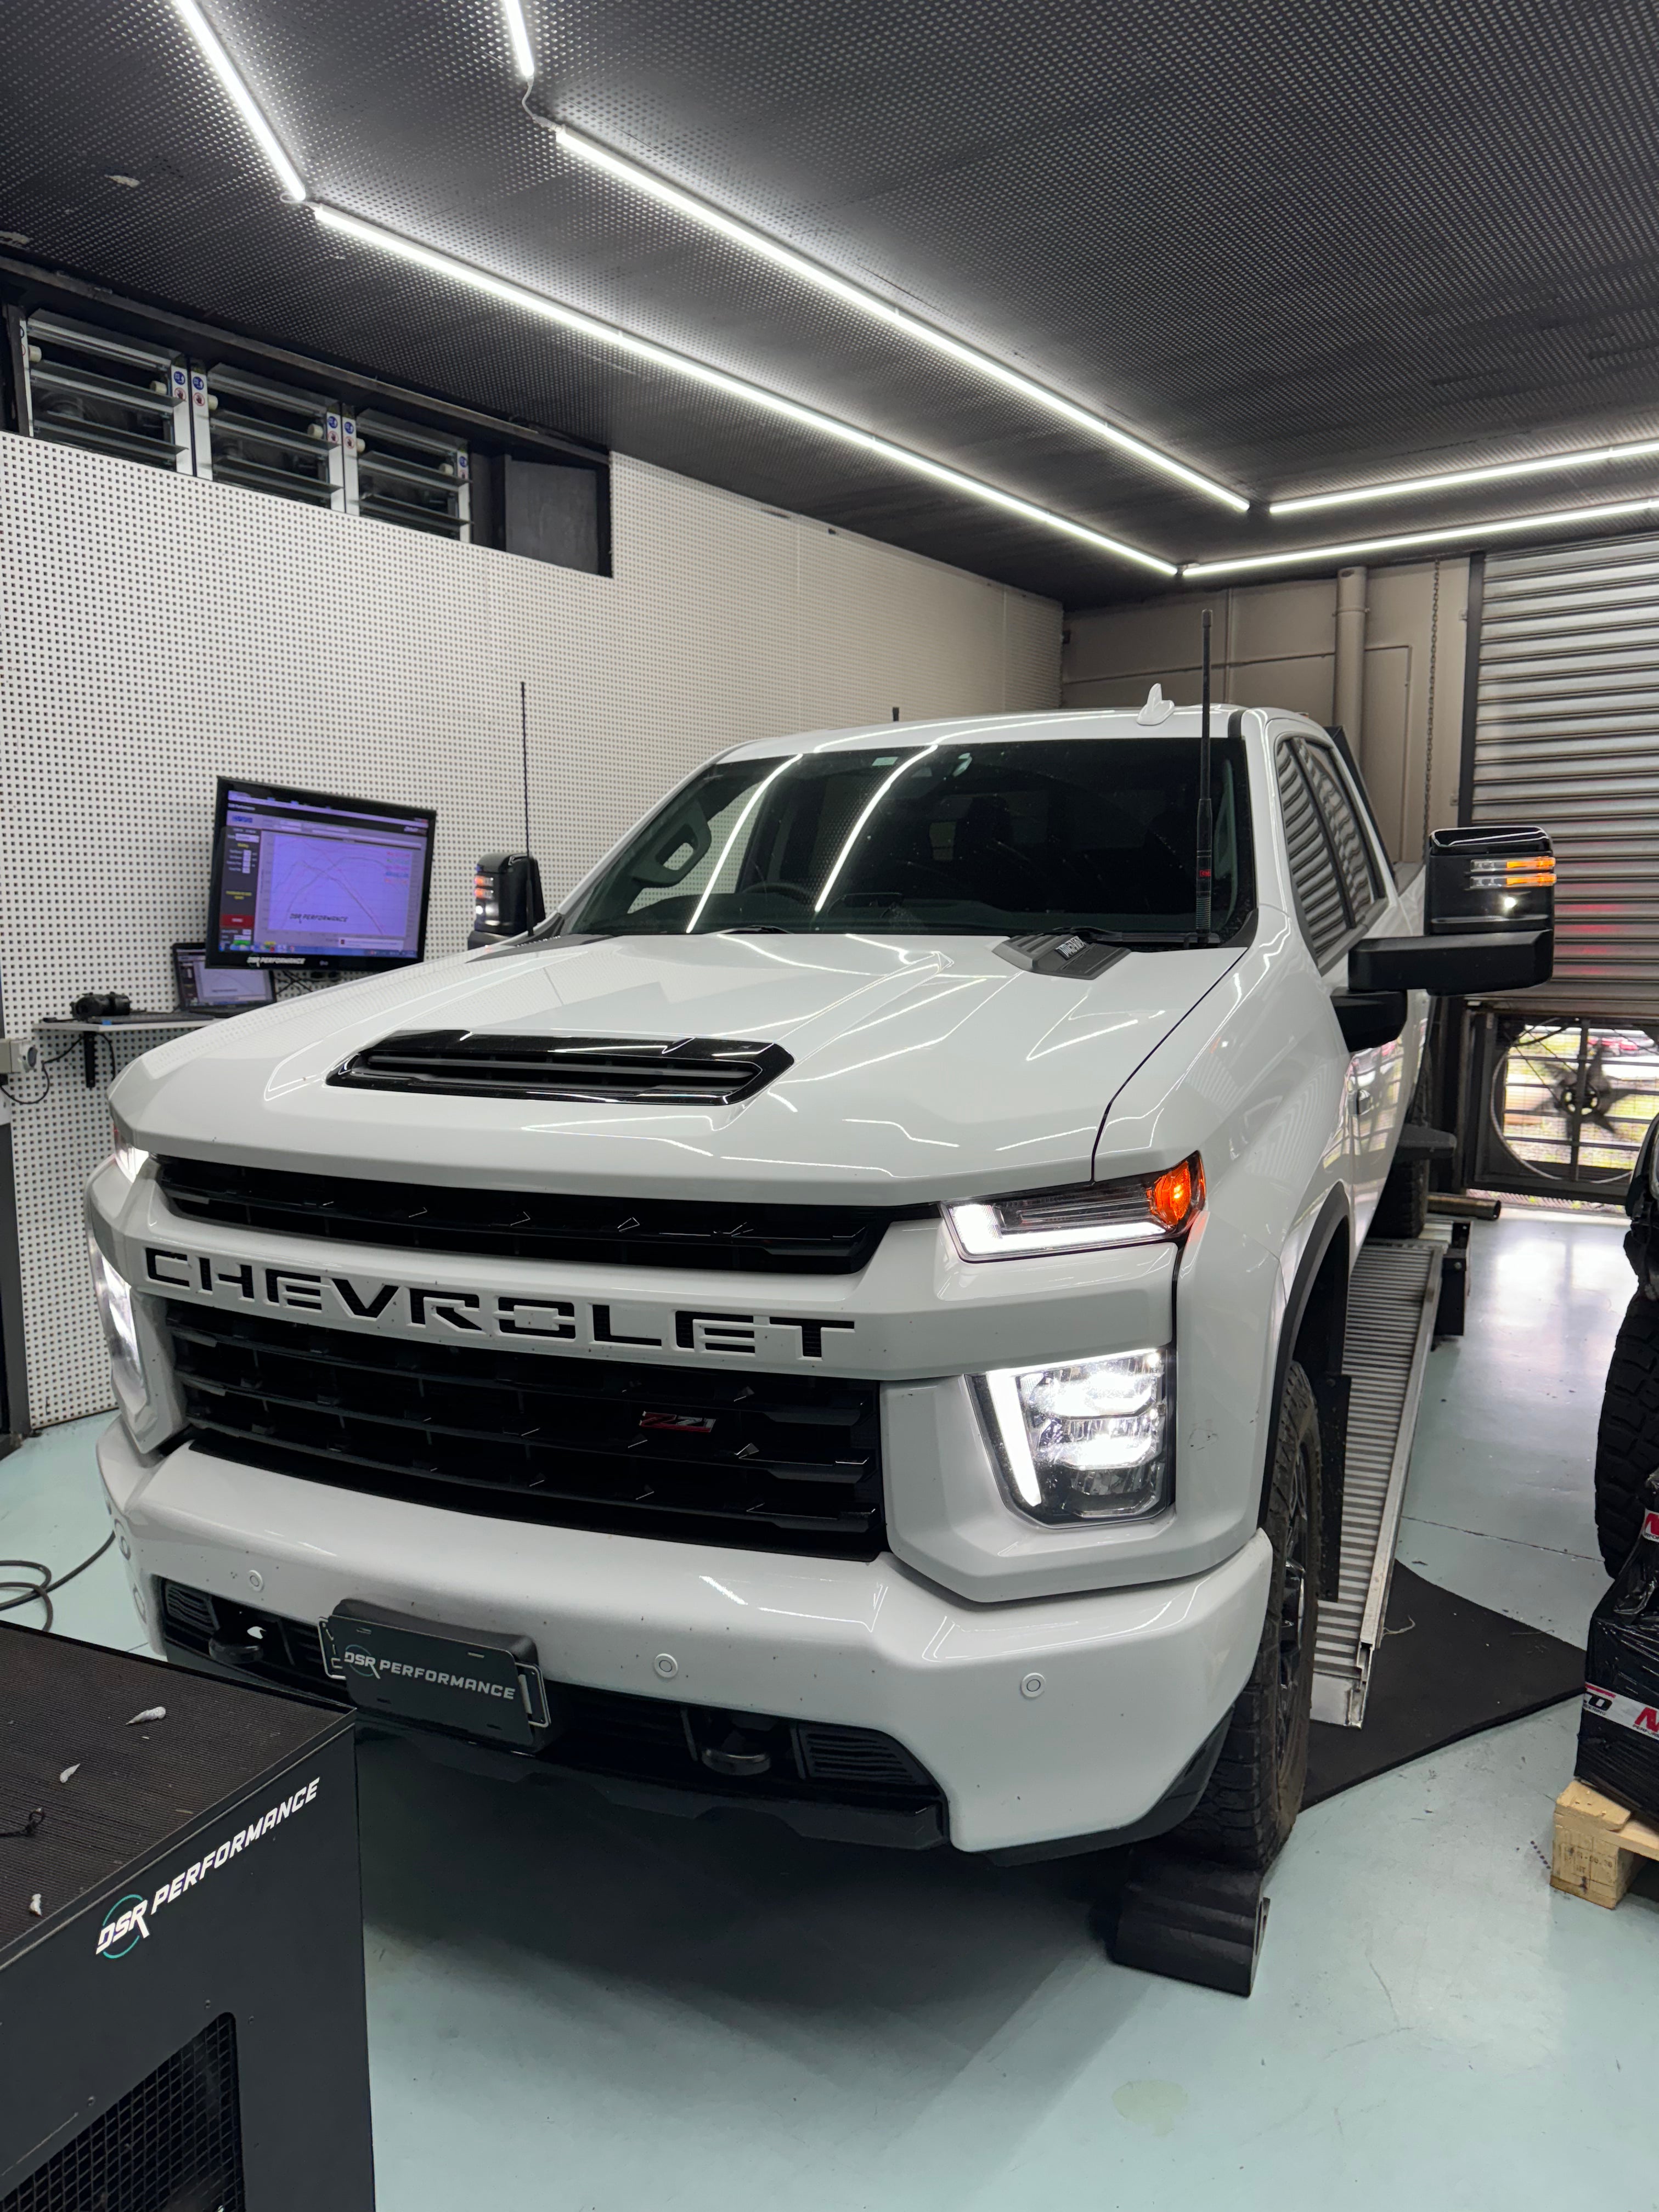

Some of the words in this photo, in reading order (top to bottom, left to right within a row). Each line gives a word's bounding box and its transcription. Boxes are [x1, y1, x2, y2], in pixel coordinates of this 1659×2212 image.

[145, 1248, 855, 1358] CHEVROLET
[344, 1651, 381, 1679] DSR
[379, 1660, 516, 1700] PERFORMANCE
[95, 1899, 150, 1955] DSR
[151, 1777, 320, 1915] PERFORMANCE
